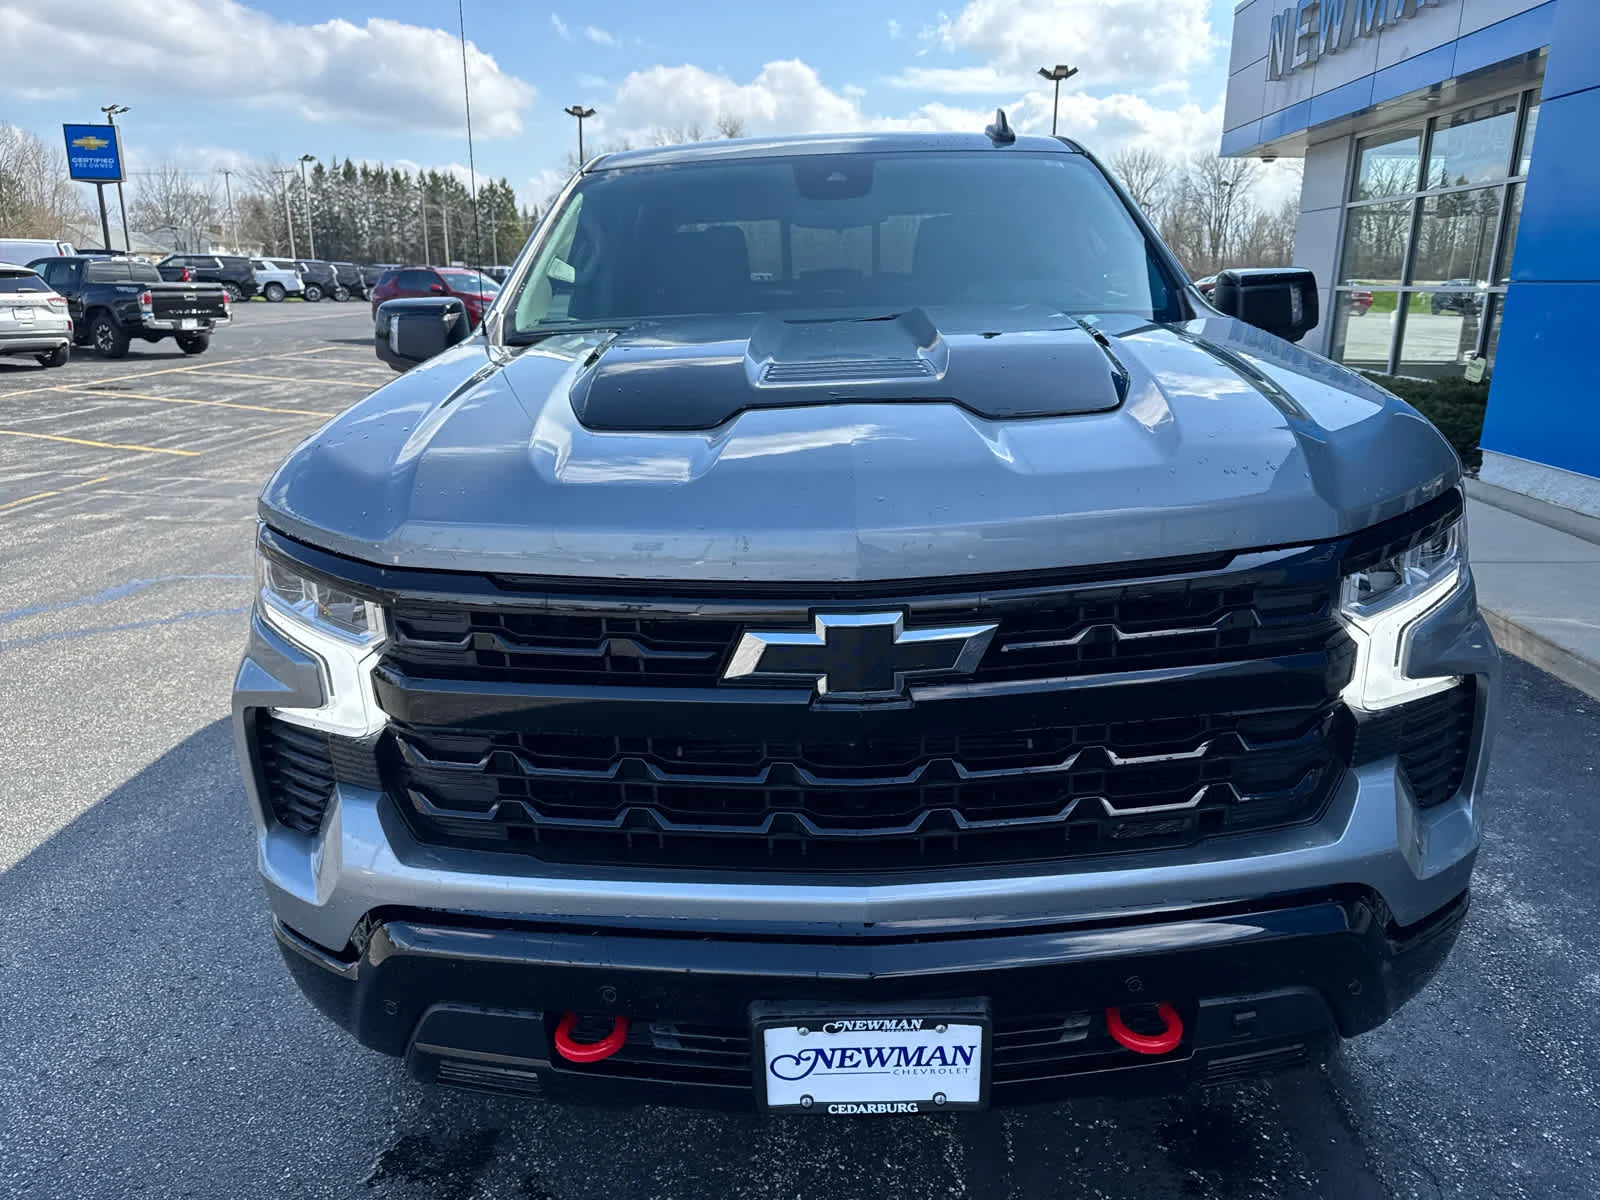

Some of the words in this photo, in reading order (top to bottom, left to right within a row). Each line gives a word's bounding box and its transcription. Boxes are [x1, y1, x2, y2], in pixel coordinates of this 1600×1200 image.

[1265, 0, 1437, 81] NEWM
[823, 1019, 923, 1034] NEWMAN
[770, 1046, 977, 1080] NEWMAN
[893, 1068, 970, 1076] CHEVROLET
[828, 1103, 919, 1114] CEDARBURG
